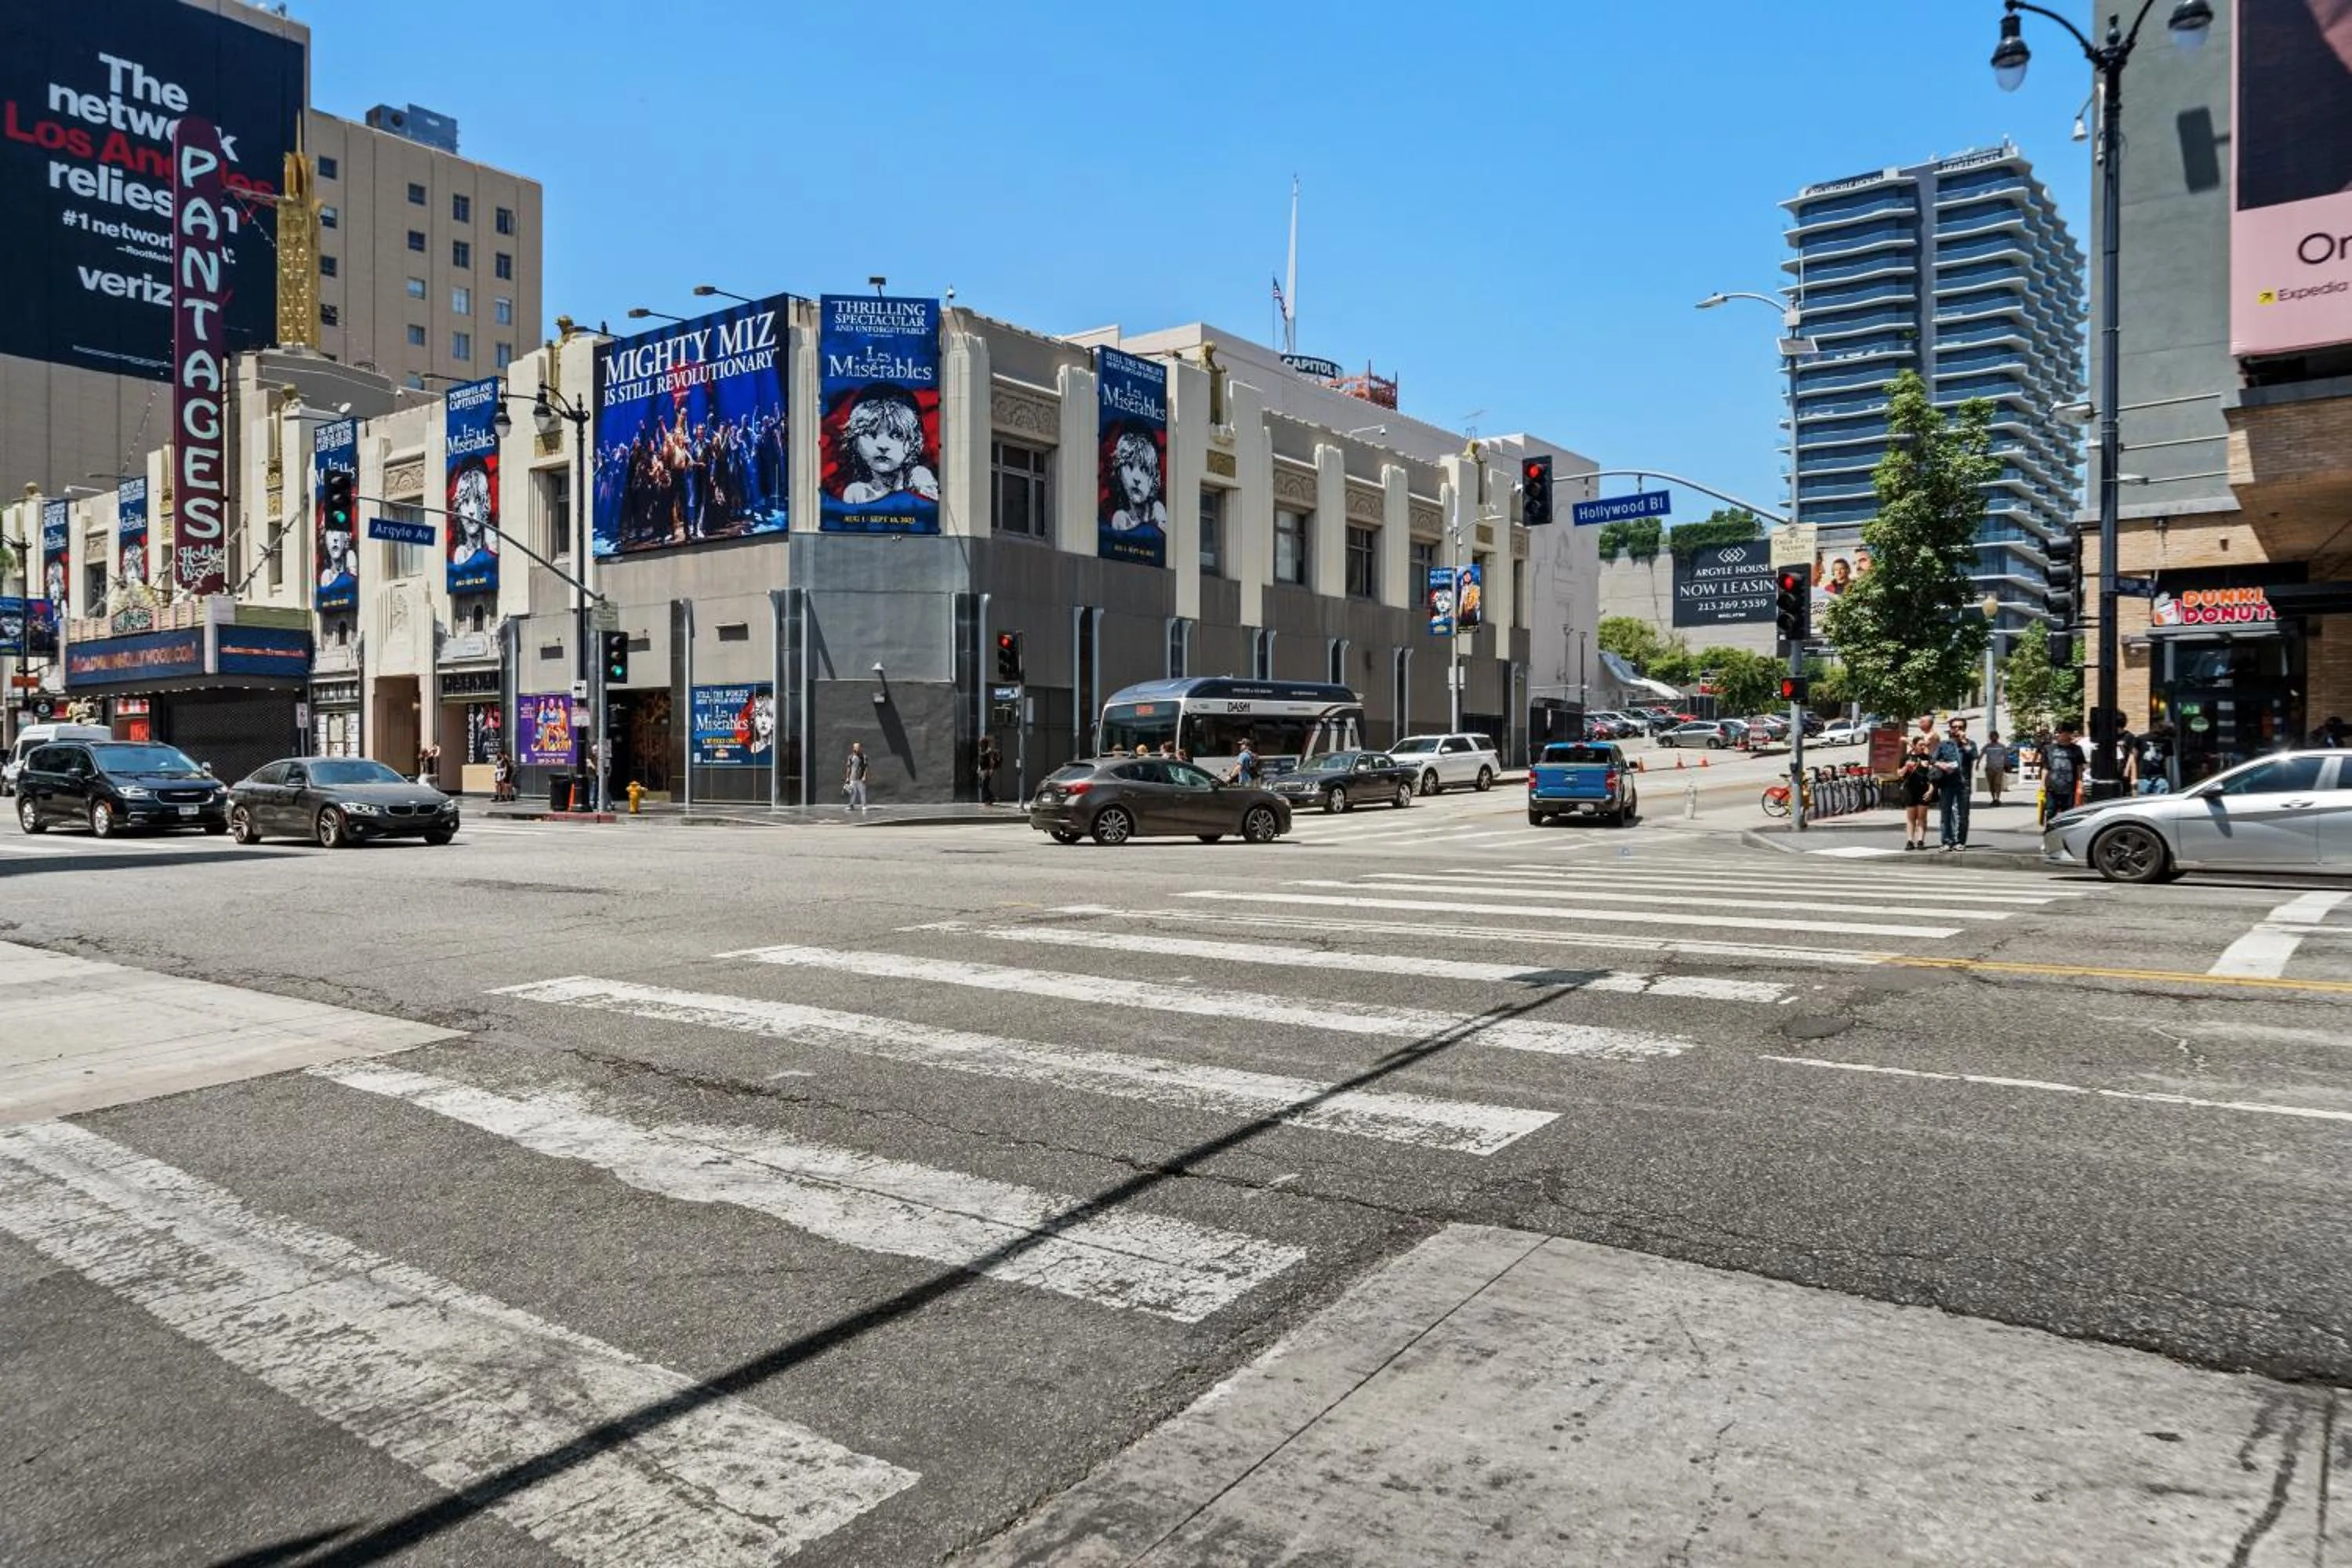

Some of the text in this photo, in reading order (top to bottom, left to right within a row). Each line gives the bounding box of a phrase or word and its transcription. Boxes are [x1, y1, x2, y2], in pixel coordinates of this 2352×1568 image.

[99, 52, 189, 111] The
[49, 82, 238, 162] netwk
[5, 100, 274, 205] Los Anles
[49, 161, 173, 217] relies
[92, 218, 173, 250] networ
[78, 266, 173, 307] veriz
[2278, 280, 2349, 302] Expedia
[834, 313, 925, 327] SPECTACULAR
[180, 144, 223, 540] PANTAGES
[717, 311, 777, 358] MIZ
[866, 346, 891, 363] Les
[828, 354, 932, 380] Misérables
[1283, 357, 1333, 376] CAPITOL
[604, 387, 615, 406] IS
[618, 381, 654, 405] STILL
[1127, 380, 1142, 399] Les
[463, 424, 476, 438] Les
[1578, 495, 1664, 523] Hollywood Bl
[375, 523, 429, 539] Argyle Av
[1695, 565, 1733, 577] ARGYLE
[1680, 579, 1775, 597] NOW LEASIN
[2183, 586, 2269, 608] DUNKI
[714, 705, 728, 718] Les
[1227, 702, 1250, 712] DASH
